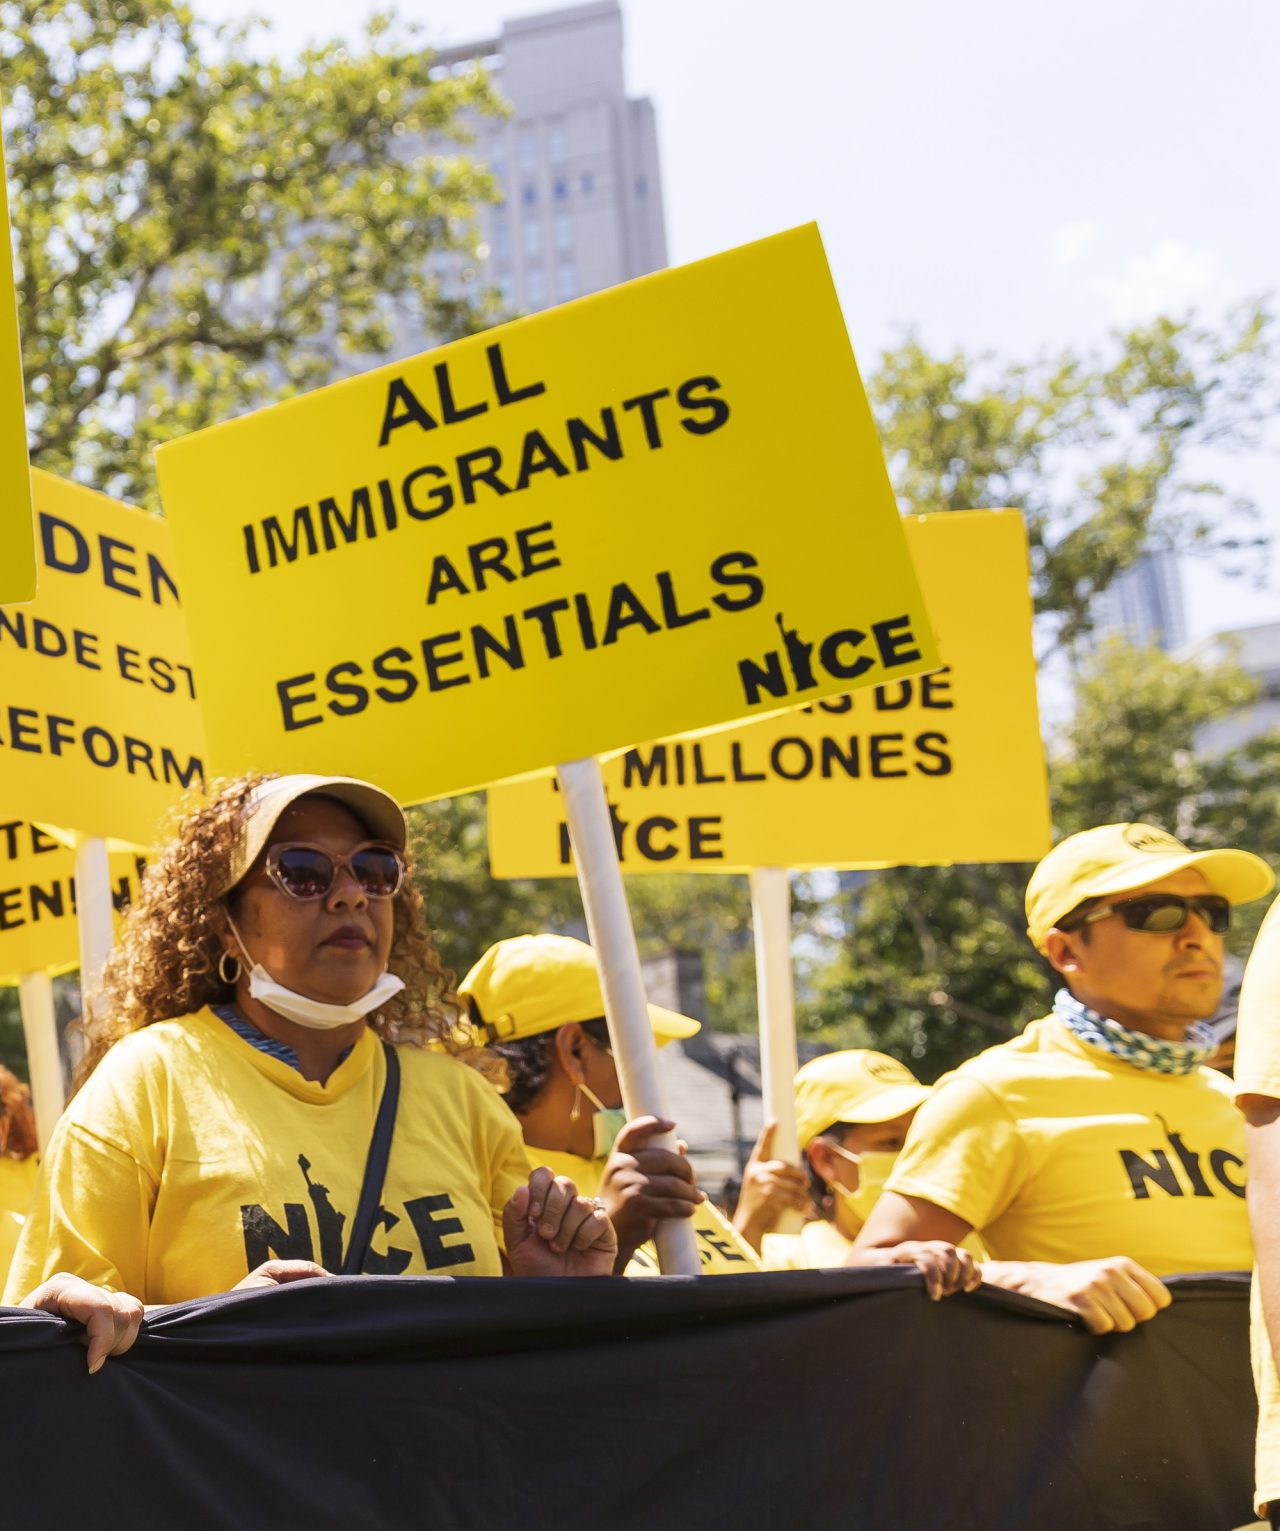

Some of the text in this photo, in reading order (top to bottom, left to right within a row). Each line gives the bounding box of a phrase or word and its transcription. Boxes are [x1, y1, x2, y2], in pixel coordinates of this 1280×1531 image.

[378, 343, 545, 447] ALL
[241, 374, 730, 574] IMMIGRANTS
[425, 520, 561, 605] ARE
[276, 550, 764, 732] ESSENTIALS
[737, 612, 921, 706] NICE
[623, 732, 953, 788] MILLONES
